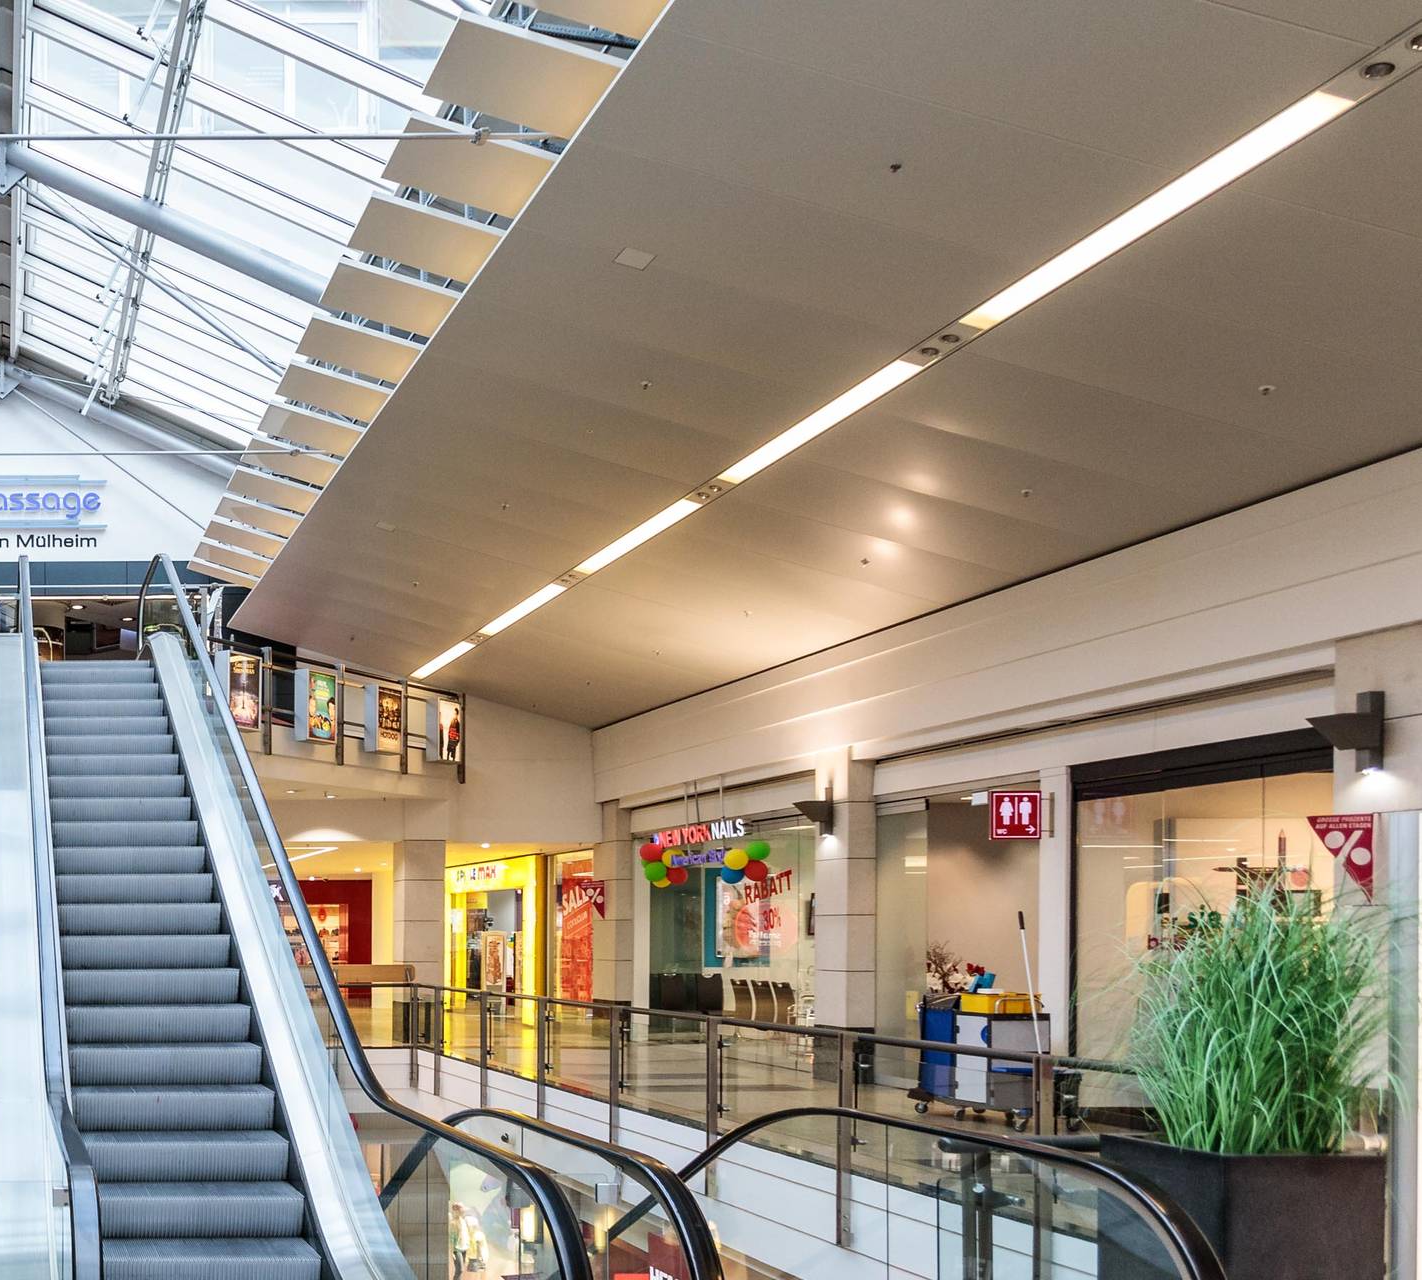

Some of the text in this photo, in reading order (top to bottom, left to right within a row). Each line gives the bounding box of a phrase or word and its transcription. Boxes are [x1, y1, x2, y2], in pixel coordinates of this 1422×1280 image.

[16, 533, 97, 548] Mülheim
[658, 818, 746, 849] NEW YORK NAILS
[744, 869, 793, 905] RABATT
